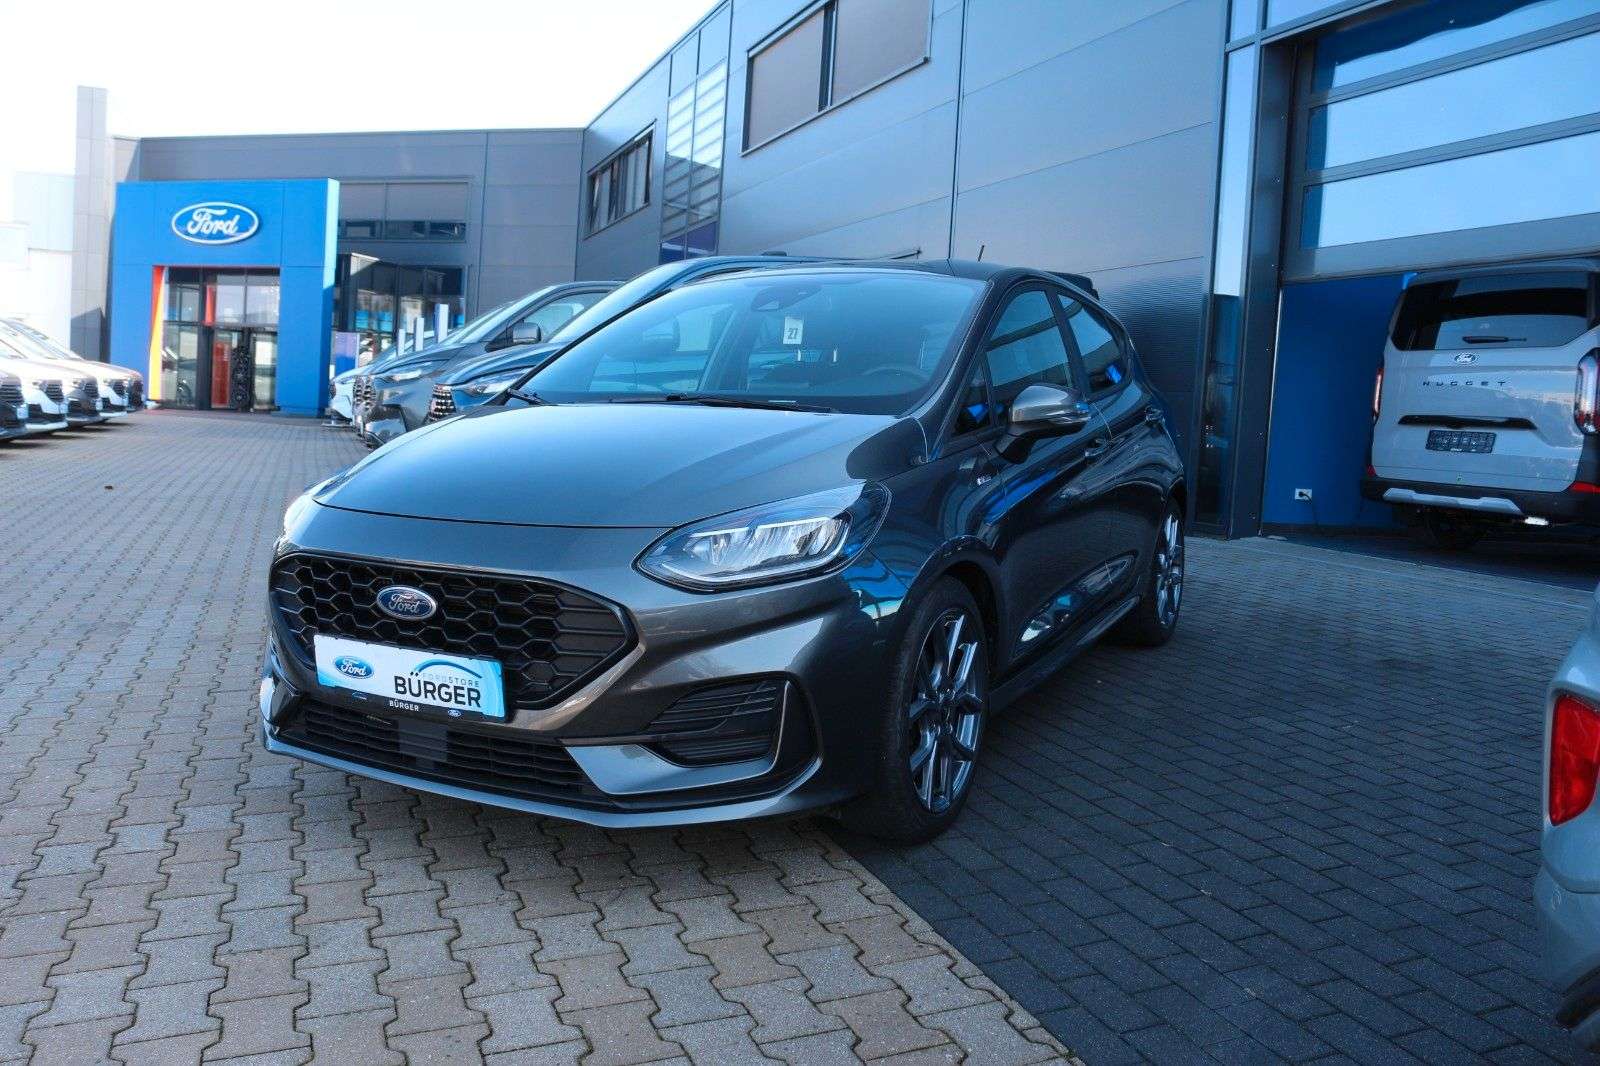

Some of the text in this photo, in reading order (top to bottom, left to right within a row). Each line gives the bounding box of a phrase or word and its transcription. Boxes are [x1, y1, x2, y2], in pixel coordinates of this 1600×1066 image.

[187, 207, 240, 235] Ford
[389, 592, 420, 613] Ford
[341, 658, 366, 676] Ford
[394, 671, 482, 708] BÜRGER
[389, 699, 419, 712] BÜRGER
